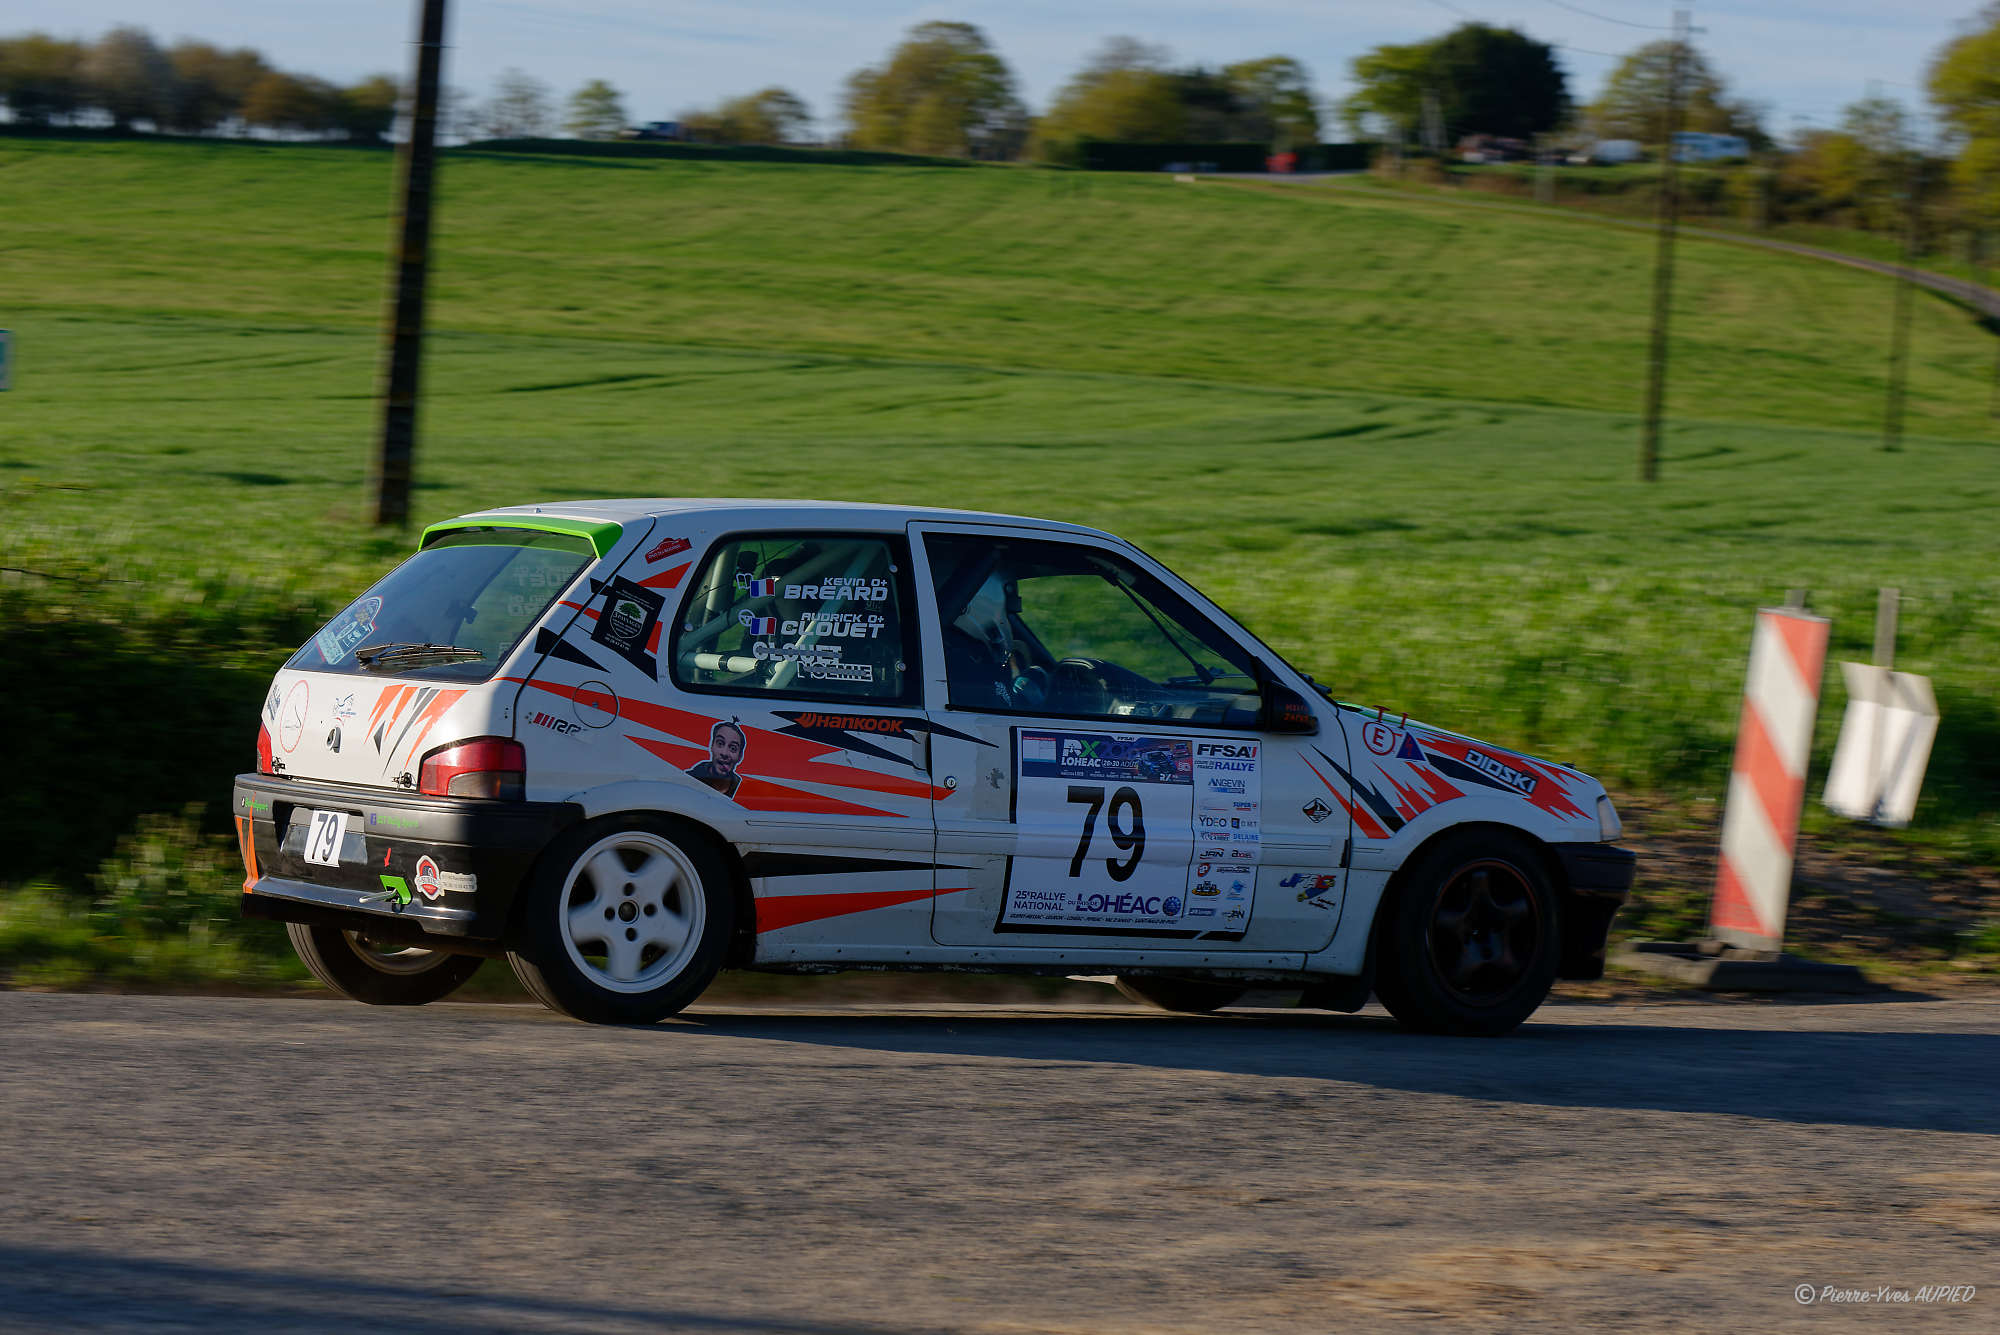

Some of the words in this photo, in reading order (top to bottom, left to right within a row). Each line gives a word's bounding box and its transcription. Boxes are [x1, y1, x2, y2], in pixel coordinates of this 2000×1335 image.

[823, 577, 865, 587] KEVIN
[784, 584, 889, 601] BREARD
[800, 612, 863, 623] AUDRICK
[780, 620, 885, 639] CLOUET
[1374, 728, 1386, 747] E
[1197, 744, 1251, 758] FFSA
[1061, 757, 1102, 769] LOHEAC
[1215, 761, 1255, 772] RALLYE
[1464, 749, 1537, 793] DIOSKI
[1208, 778, 1246, 788] ANGEVIN
[311, 813, 340, 862] 79
[1066, 785, 1146, 882] 79
[1030, 891, 1066, 902] RALLYE
[1014, 901, 1065, 911] NATIONAL
[1075, 893, 1161, 915] LOHÉAC
